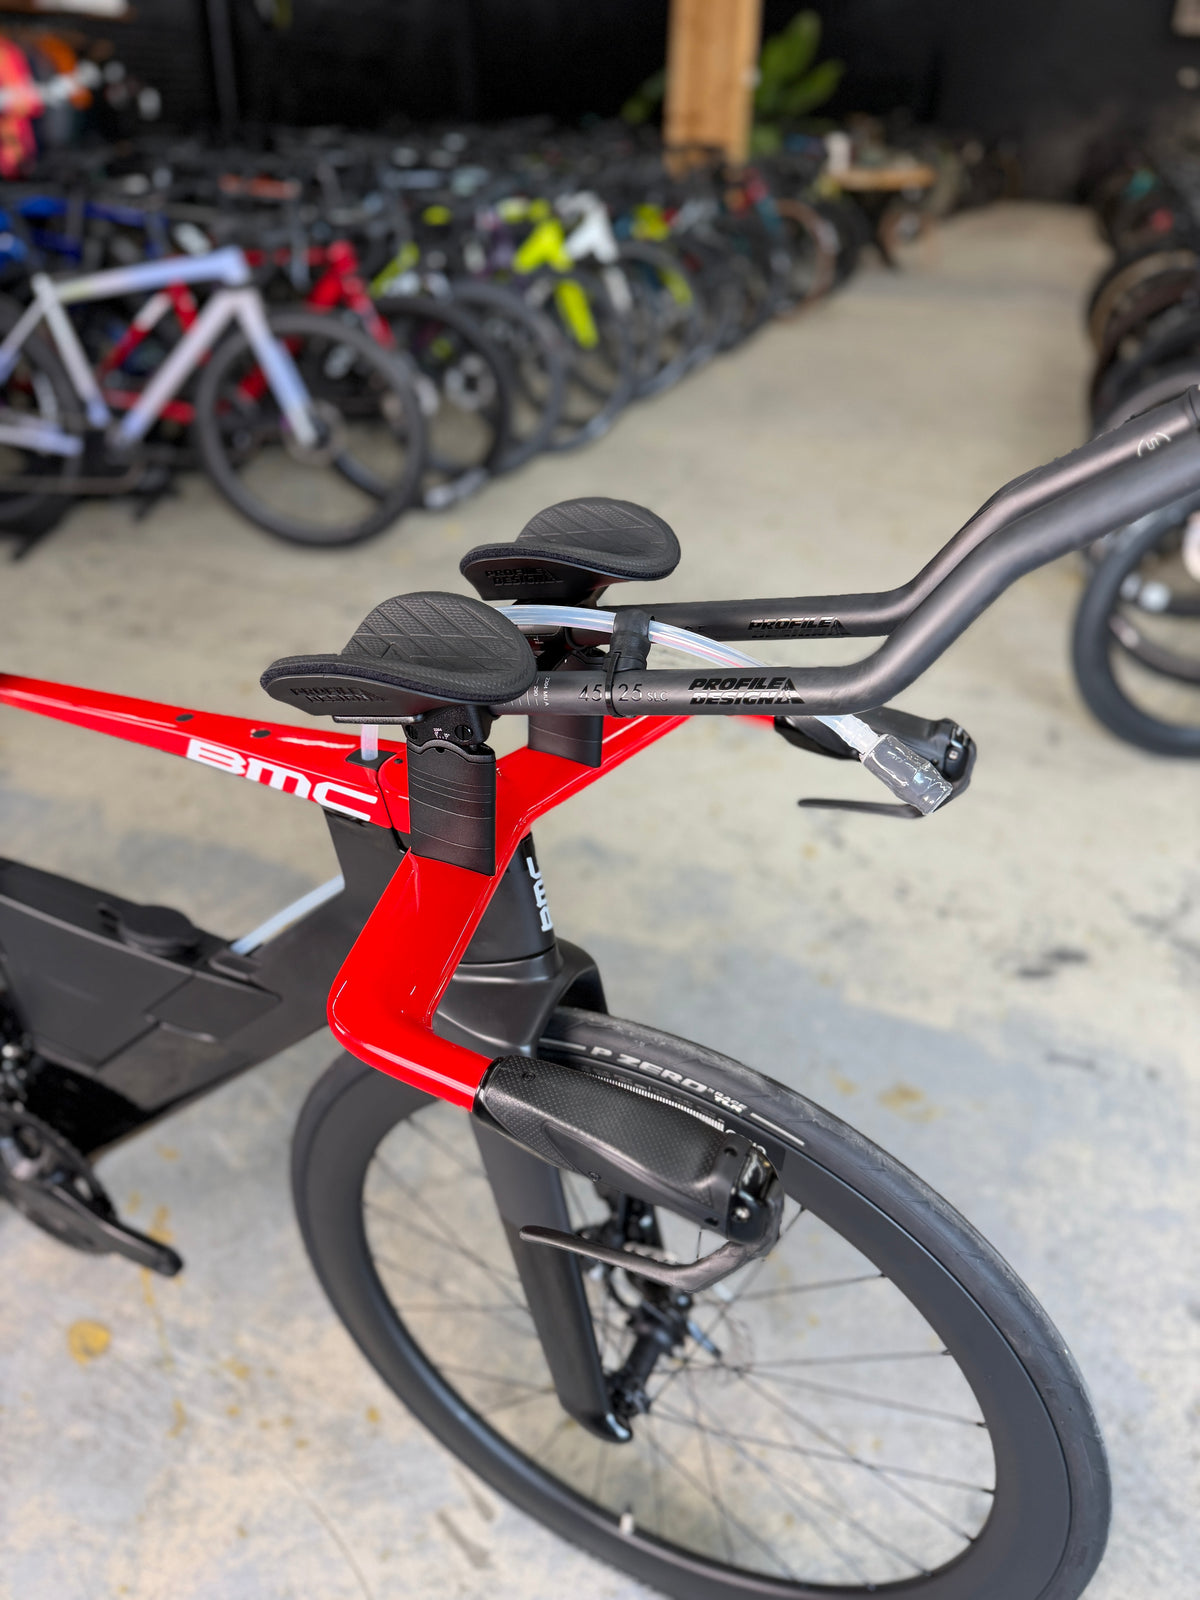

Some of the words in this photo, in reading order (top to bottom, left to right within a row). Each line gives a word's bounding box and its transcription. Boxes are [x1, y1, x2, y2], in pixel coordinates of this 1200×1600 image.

[485, 568, 544, 578] PROFILE
[494, 575, 544, 587] DESIGN
[748, 616, 834, 630] PROFILE
[688, 677, 787, 691] PROFILE
[647, 692, 668, 702] SLC
[690, 691, 782, 705] DESIGN
[187, 738, 378, 822] BMC
[526, 856, 553, 932] BMC
[591, 1046, 612, 1057] P
[617, 1053, 708, 1093] ZERO
